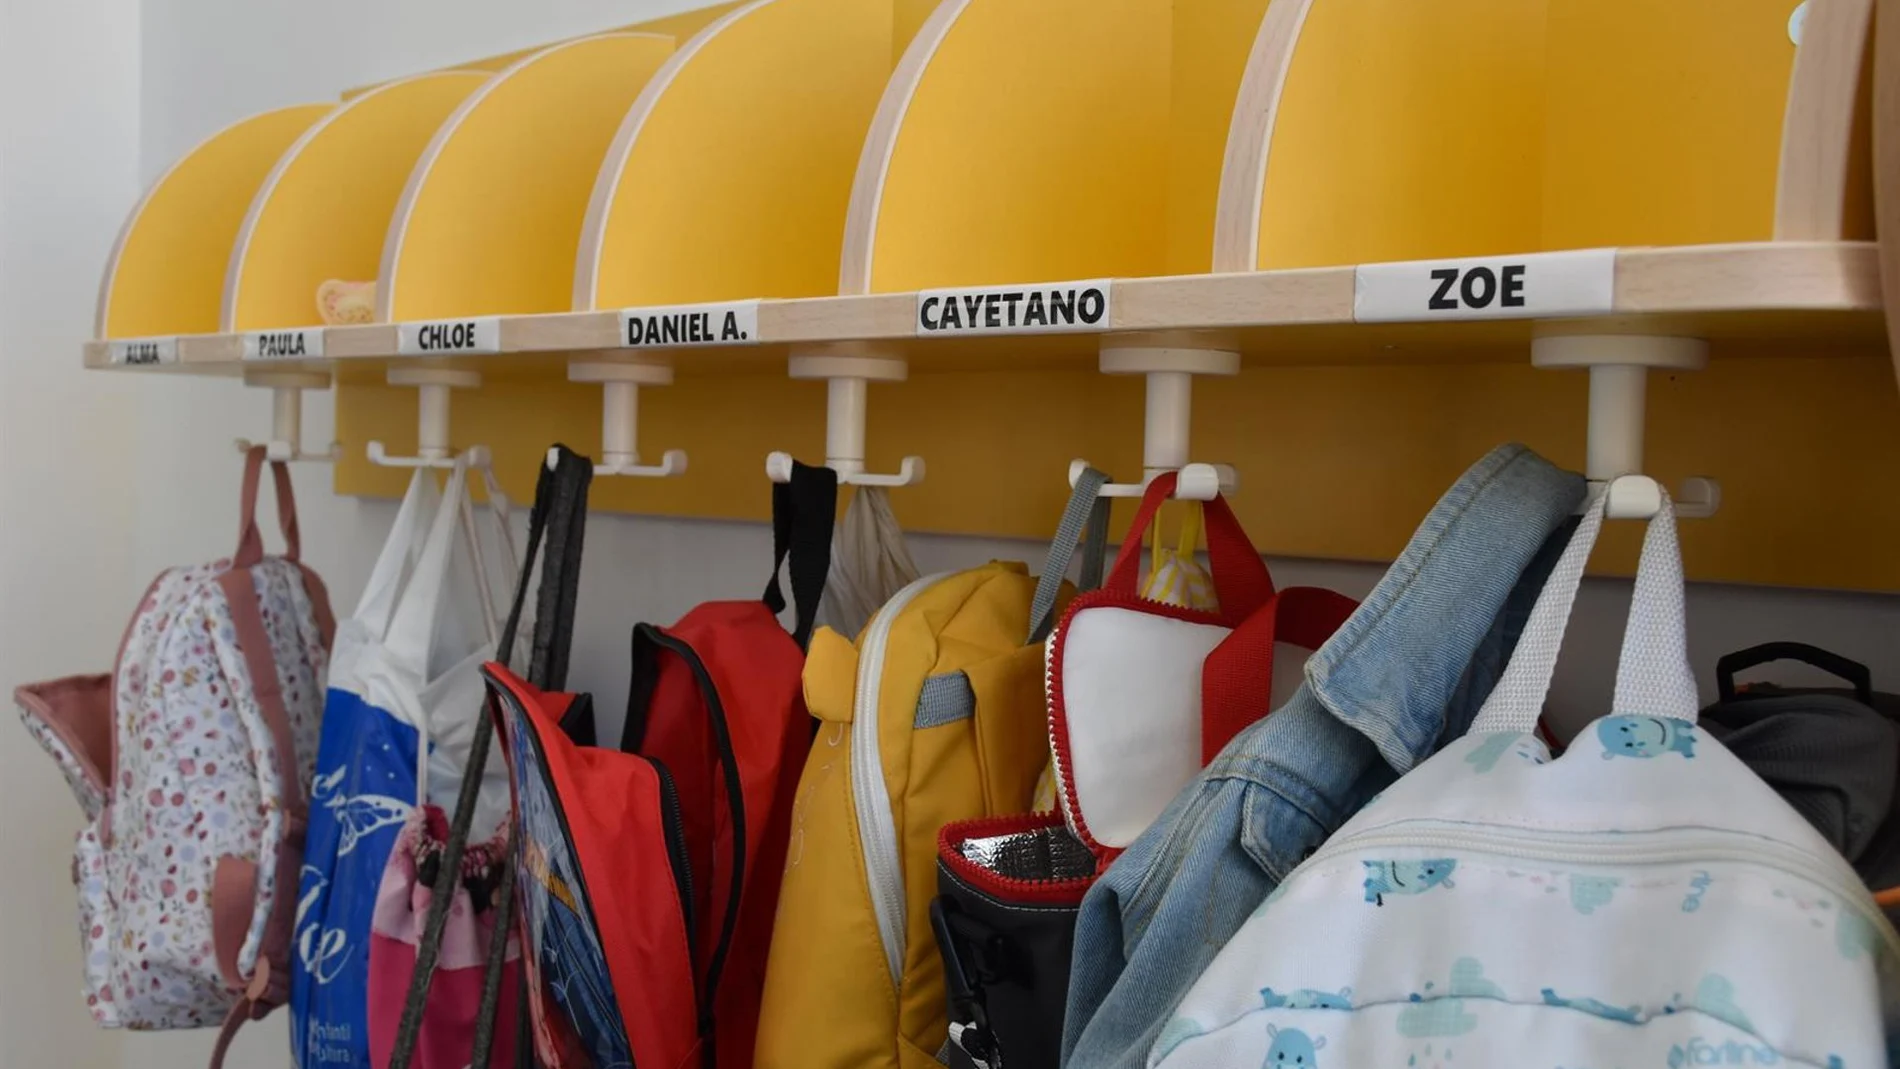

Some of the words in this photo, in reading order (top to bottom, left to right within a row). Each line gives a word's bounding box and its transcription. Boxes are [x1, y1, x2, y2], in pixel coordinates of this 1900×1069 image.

[1429, 264, 1526, 310] ZOE
[920, 288, 1105, 331] CAYETANO
[418, 322, 476, 351] CHLOE
[628, 312, 714, 345] DANIEL
[721, 311, 748, 341] A.
[124, 344, 161, 365] ALMA
[259, 333, 306, 356] PAULA
